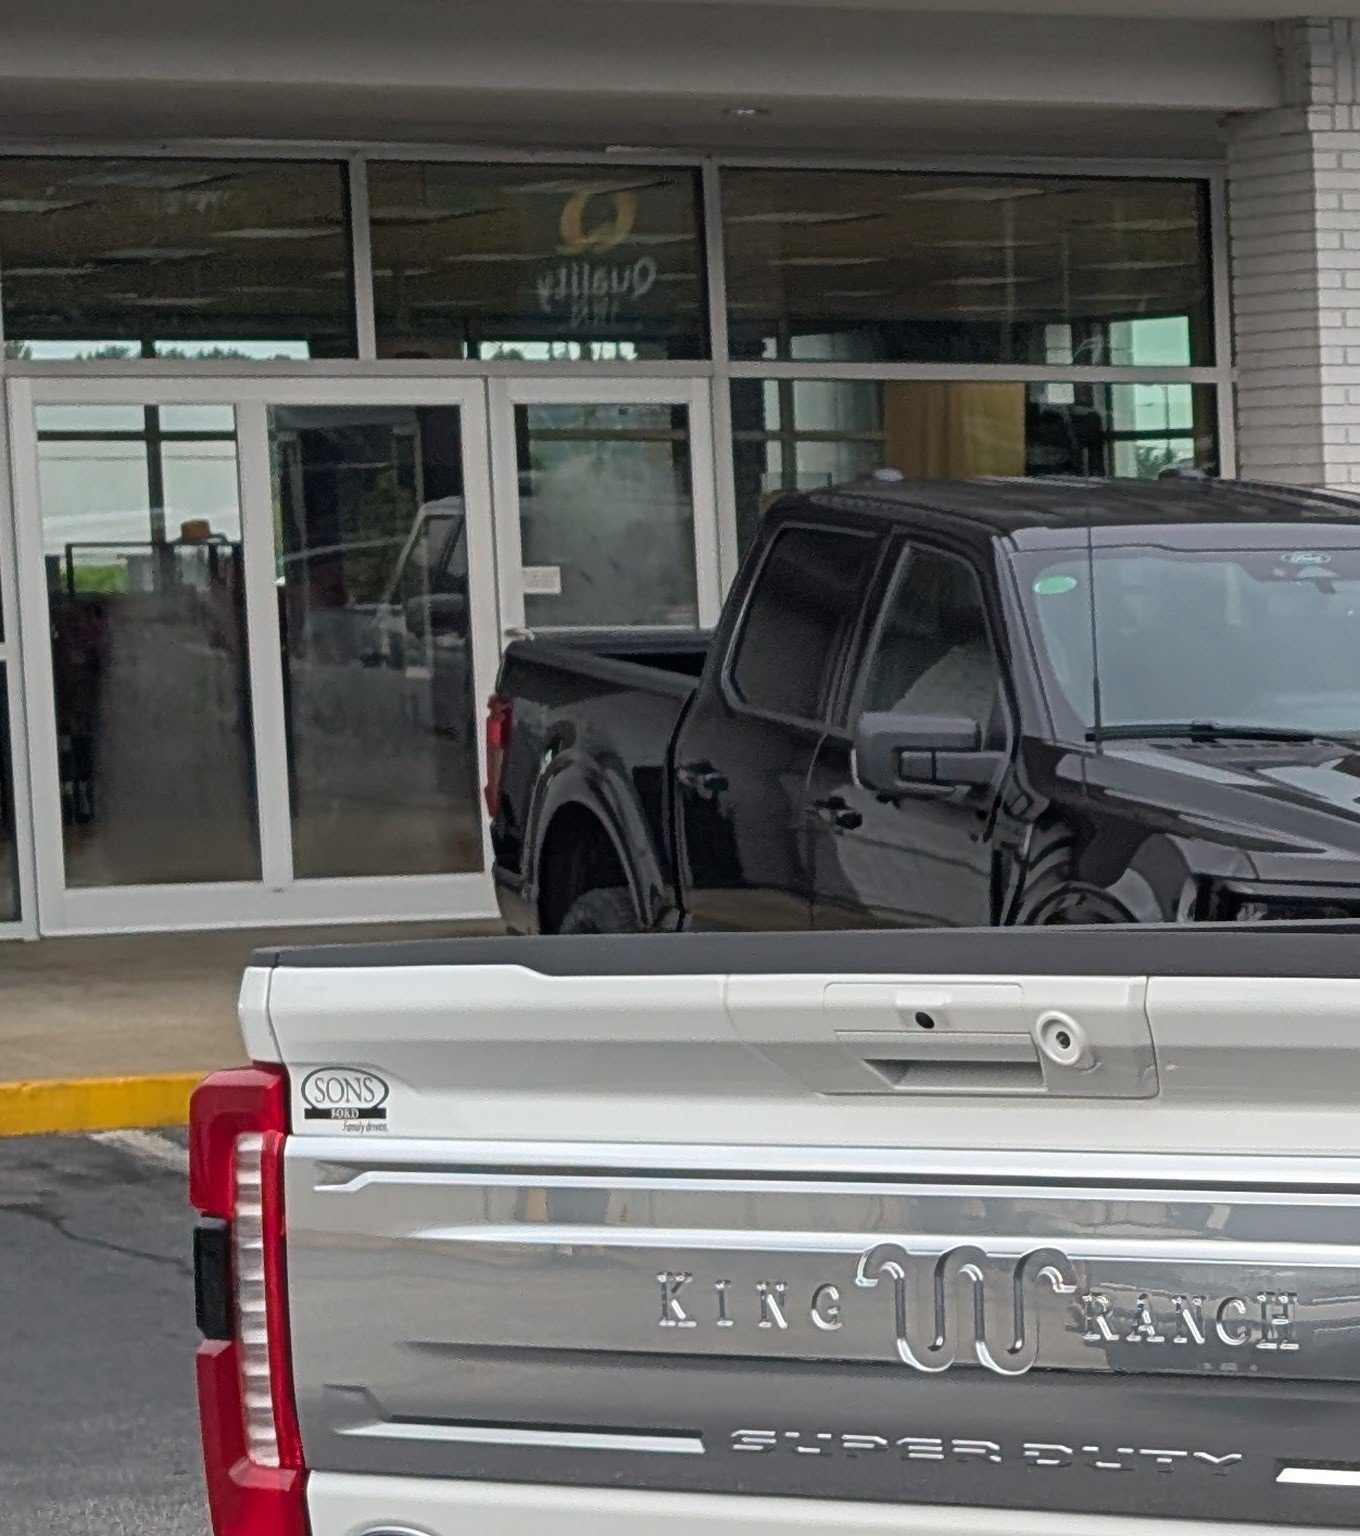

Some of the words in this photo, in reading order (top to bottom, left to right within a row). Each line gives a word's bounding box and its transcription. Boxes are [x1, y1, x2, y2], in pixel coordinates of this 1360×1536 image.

[314, 1077, 375, 1103] SONS
[655, 1270, 844, 1331] KING
[1081, 1289, 1300, 1351] RANCH
[730, 1429, 1002, 1464] SUPER
[1022, 1442, 1243, 1475] DUTY
